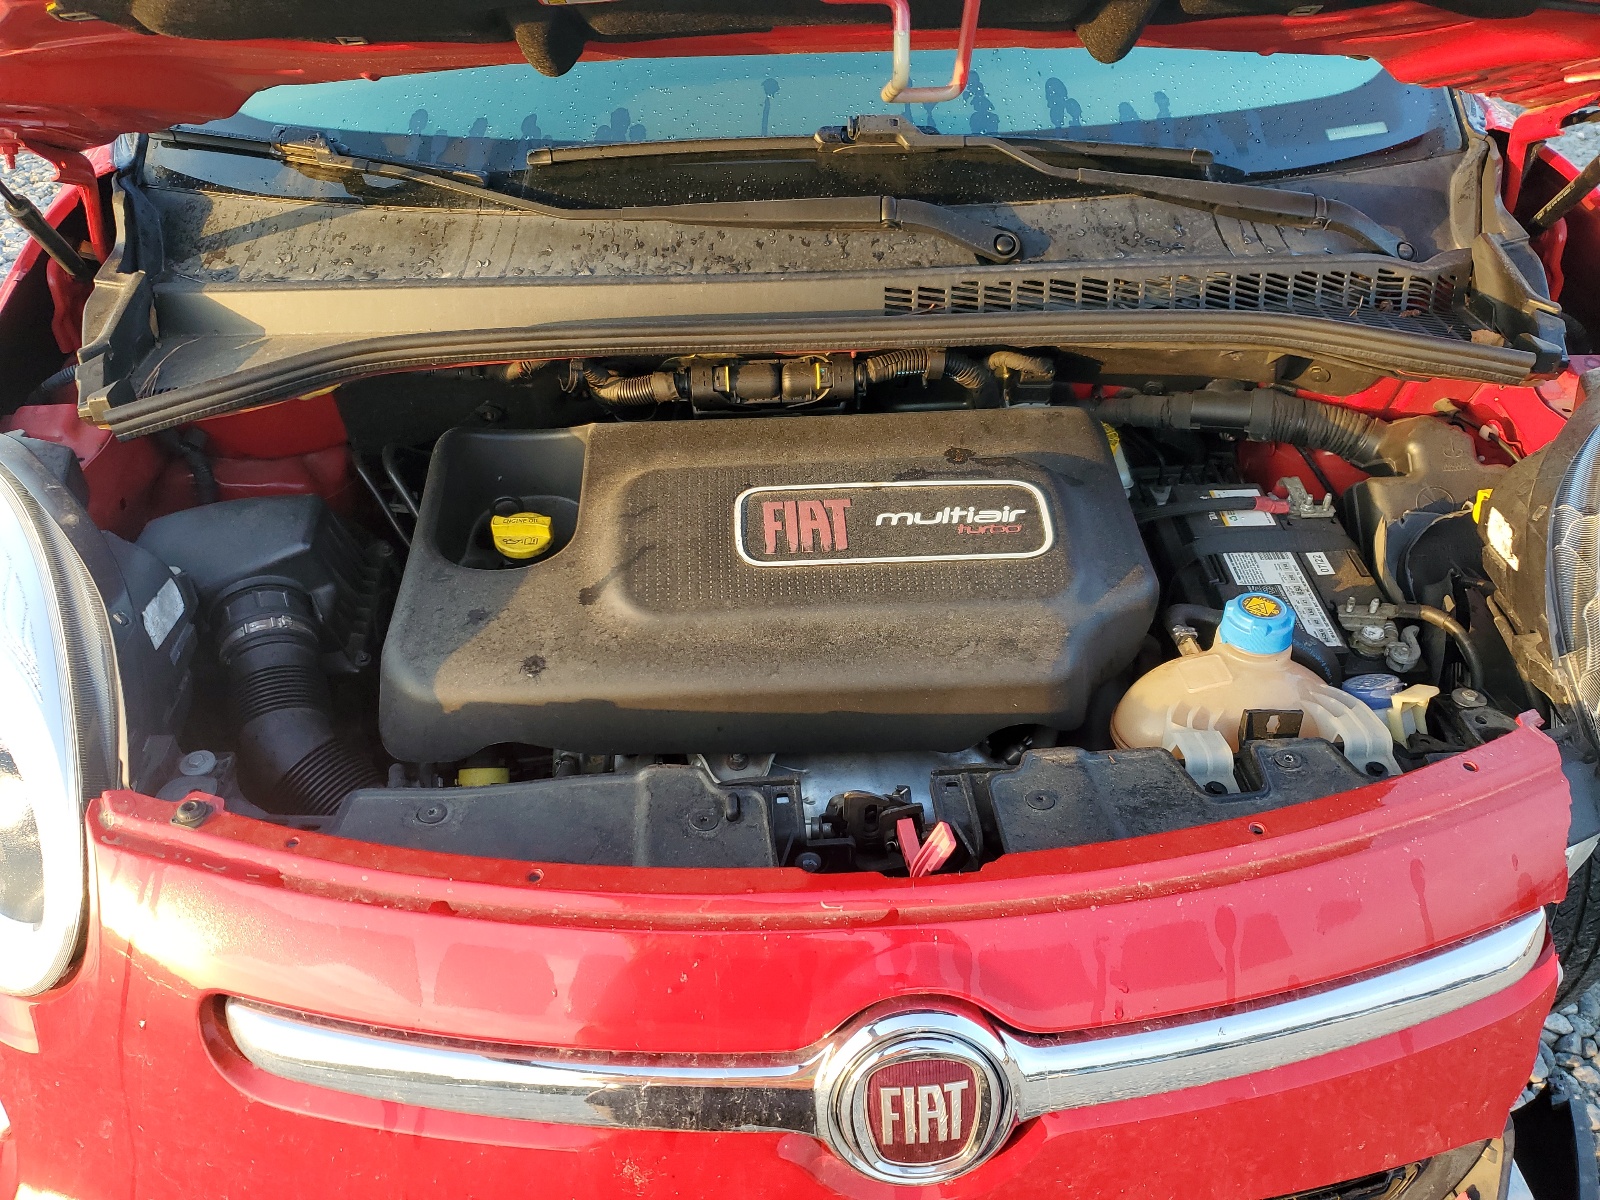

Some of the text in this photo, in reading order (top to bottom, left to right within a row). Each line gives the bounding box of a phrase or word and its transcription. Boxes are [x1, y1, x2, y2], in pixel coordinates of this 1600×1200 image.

[763, 498, 852, 554] FIAT
[875, 506, 1026, 527] multiair
[957, 523, 1022, 535] turbo
[879, 1079, 969, 1145] FIAT
